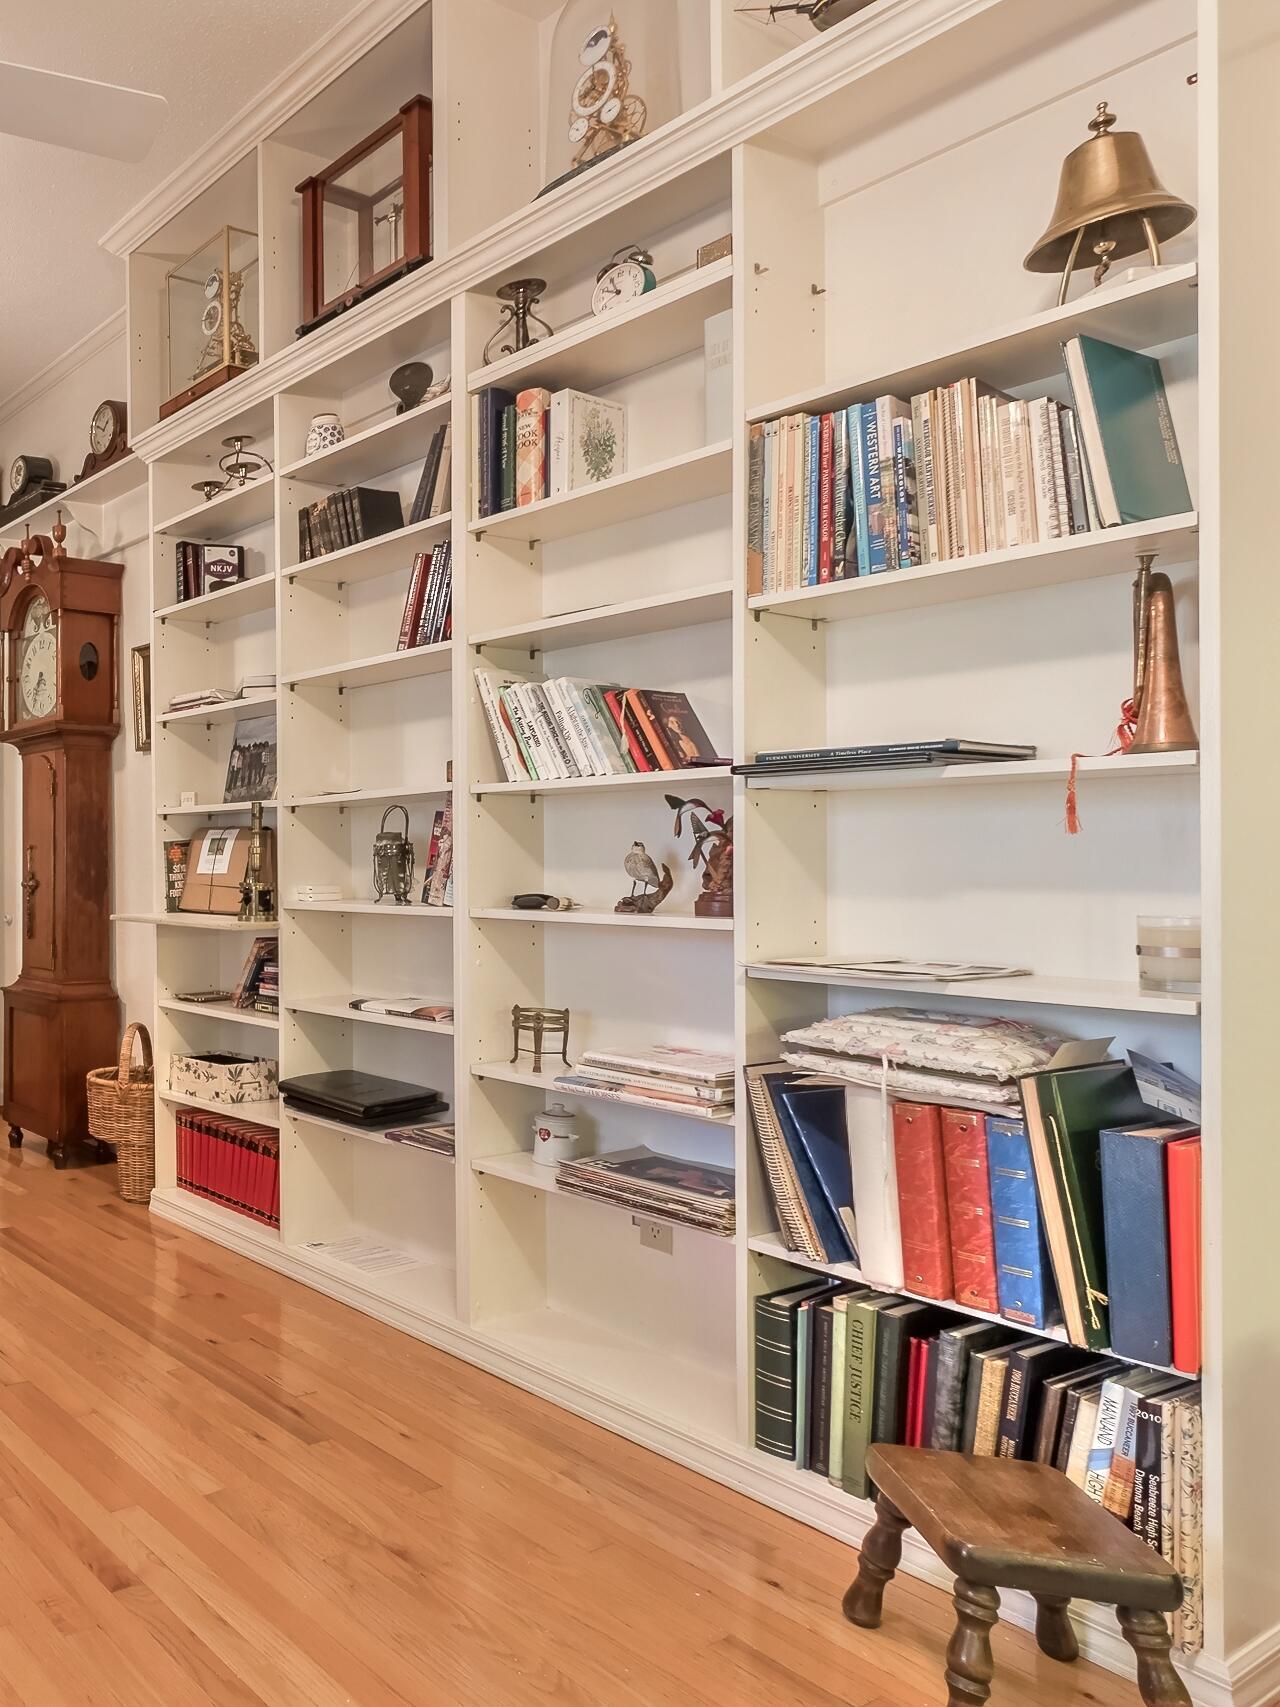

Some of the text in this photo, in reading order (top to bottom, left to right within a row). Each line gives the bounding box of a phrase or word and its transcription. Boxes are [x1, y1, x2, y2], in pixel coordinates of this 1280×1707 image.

[866, 420, 880, 499] WESTERN ART
[922, 419, 930, 457] WATERCOLOR
[927, 488, 935, 525] TECHNIQUES
[210, 564, 233, 573] NKJV
[848, 1319, 864, 1423] CHIEF JUSTICE
[1098, 1395, 1118, 1447] MAINLAND
[1135, 1409, 1162, 1424] 2010
[1121, 1420, 1136, 1457] BUCCANEER
[1086, 1471, 1105, 1503] HIGH
[1133, 1469, 1145, 1501] Daytona
[1148, 1474, 1160, 1515] Seabreeze
[1147, 1515, 1159, 1537] High
